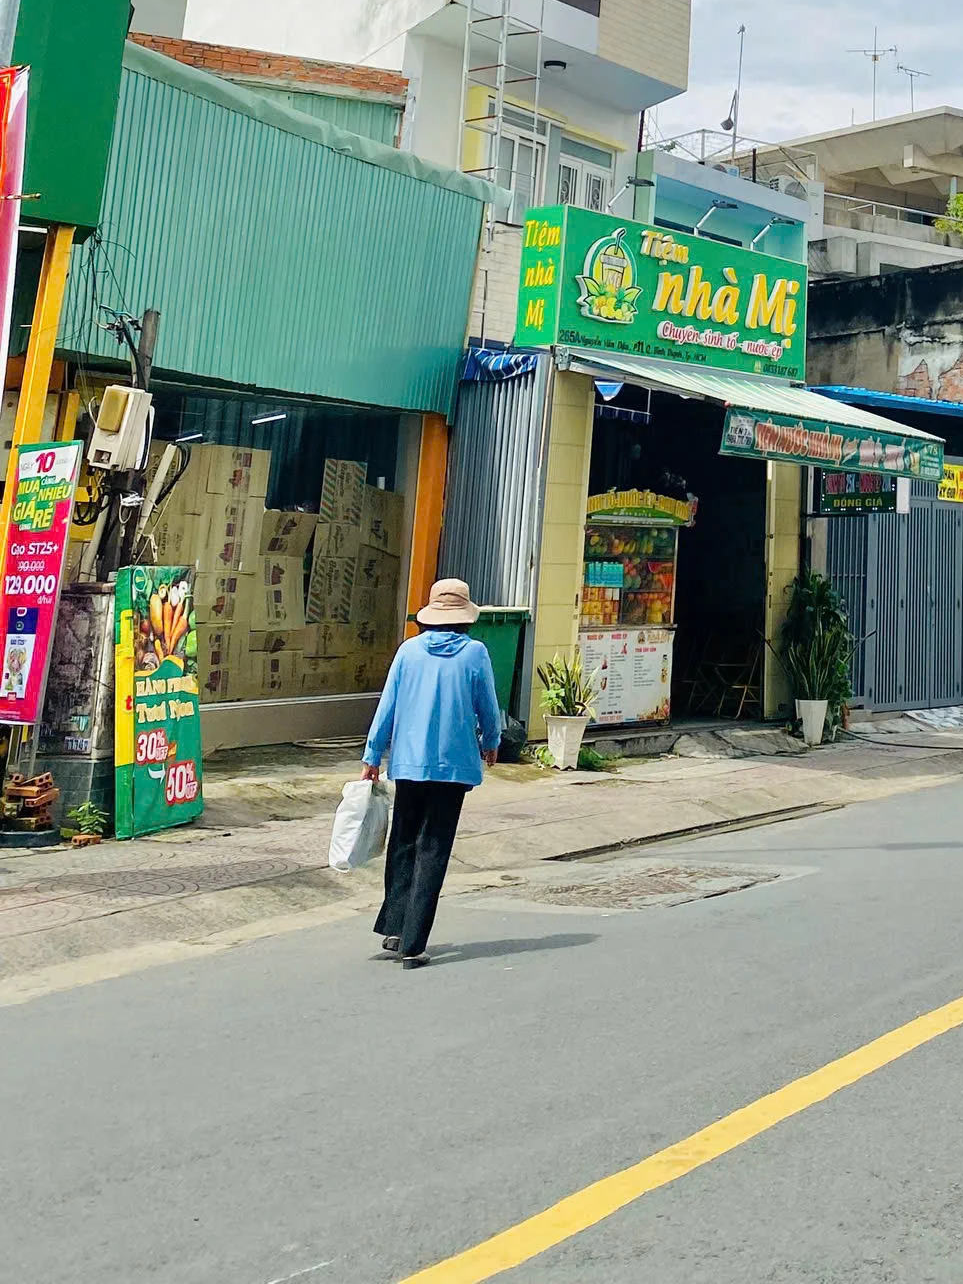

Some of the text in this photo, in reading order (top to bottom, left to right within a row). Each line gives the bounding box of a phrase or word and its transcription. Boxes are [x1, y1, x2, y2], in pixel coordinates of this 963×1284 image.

[524, 219, 561, 252] Tiệm
[640, 229, 689, 265] Tiệm
[524, 258, 555, 287] nhà
[652, 265, 740, 325] nhà
[525, 299, 545, 331] Mị
[745, 273, 800, 349] Mị
[559, 329, 581, 343] 265A
[660, 321, 700, 345] Chuyên
[702, 329, 723, 348] sinh
[725, 332, 739, 350] tố
[35, 451, 56, 473] 10
[17, 479, 40, 495] MUA
[13, 496, 37, 522] GIÁ
[32, 502, 54, 529] RẺ
[27, 541, 59, 555] ST25+
[5, 574, 56, 595] 129.000
[156, 746, 169, 761] OFF
